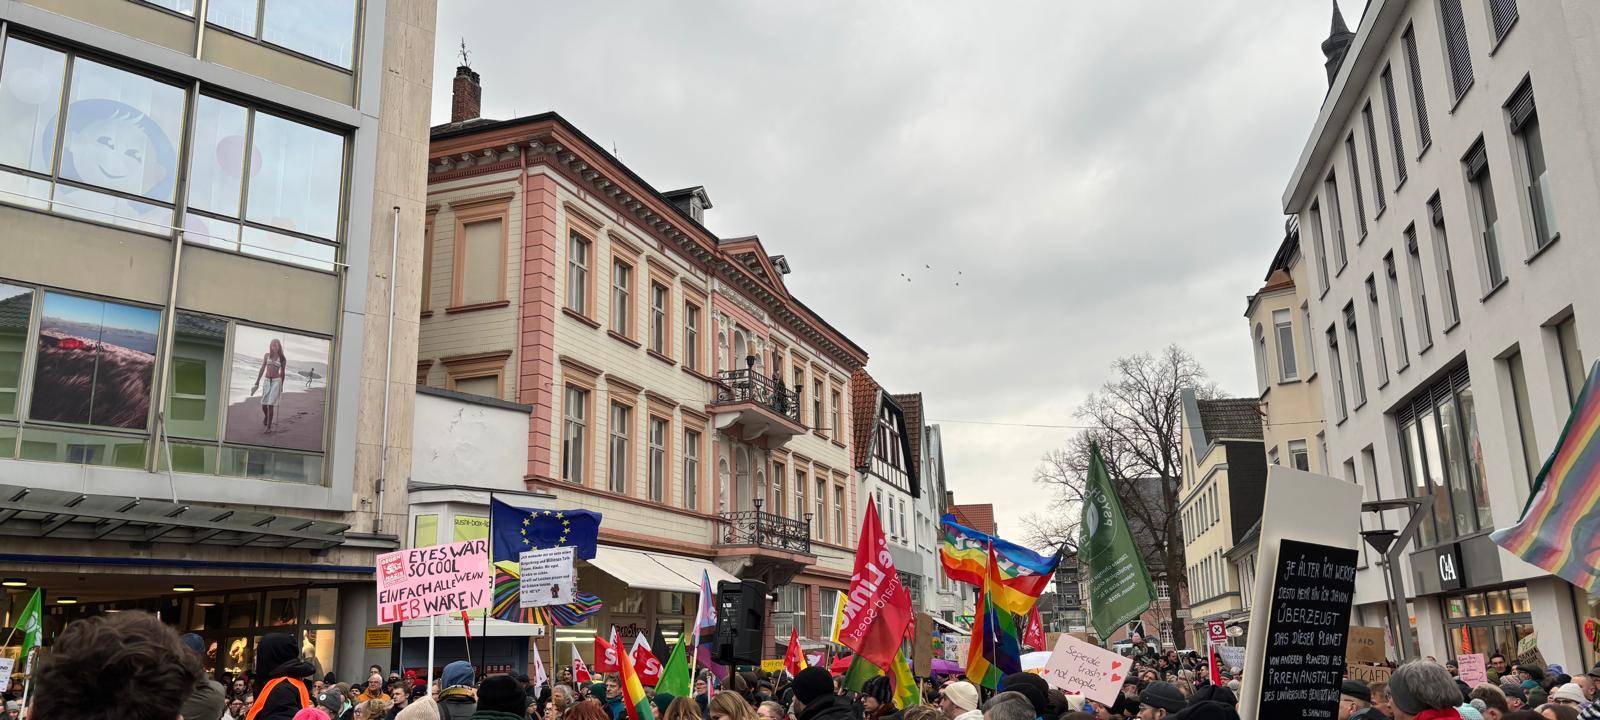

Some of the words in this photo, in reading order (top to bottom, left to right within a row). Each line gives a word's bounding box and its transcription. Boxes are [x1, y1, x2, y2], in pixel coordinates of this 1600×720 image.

[409, 549, 427, 564] EY
[429, 547, 447, 561] ES
[449, 540, 487, 558] WÄR
[408, 563, 426, 578] SO
[427, 559, 460, 576] COOL
[454, 571, 484, 584] WENN
[1283, 560, 1297, 581] JE
[1335, 565, 1356, 582] WERDE
[1439, 553, 1457, 582] C&A
[379, 581, 432, 605] EINFACH
[433, 579, 457, 593] ALLE
[381, 598, 421, 623] LIEB
[423, 589, 483, 614] WÄREN
[1277, 602, 1340, 626] ÜBERZEUGT
[1273, 632, 1289, 646] DAS
[1318, 630, 1342, 646] PLANET
[1269, 655, 1279, 666] VON
[1305, 653, 1330, 665] PLANETEN
[1054, 668, 1069, 679] not
[1068, 676, 1097, 691] people.
[1264, 690, 1275, 702] DES
